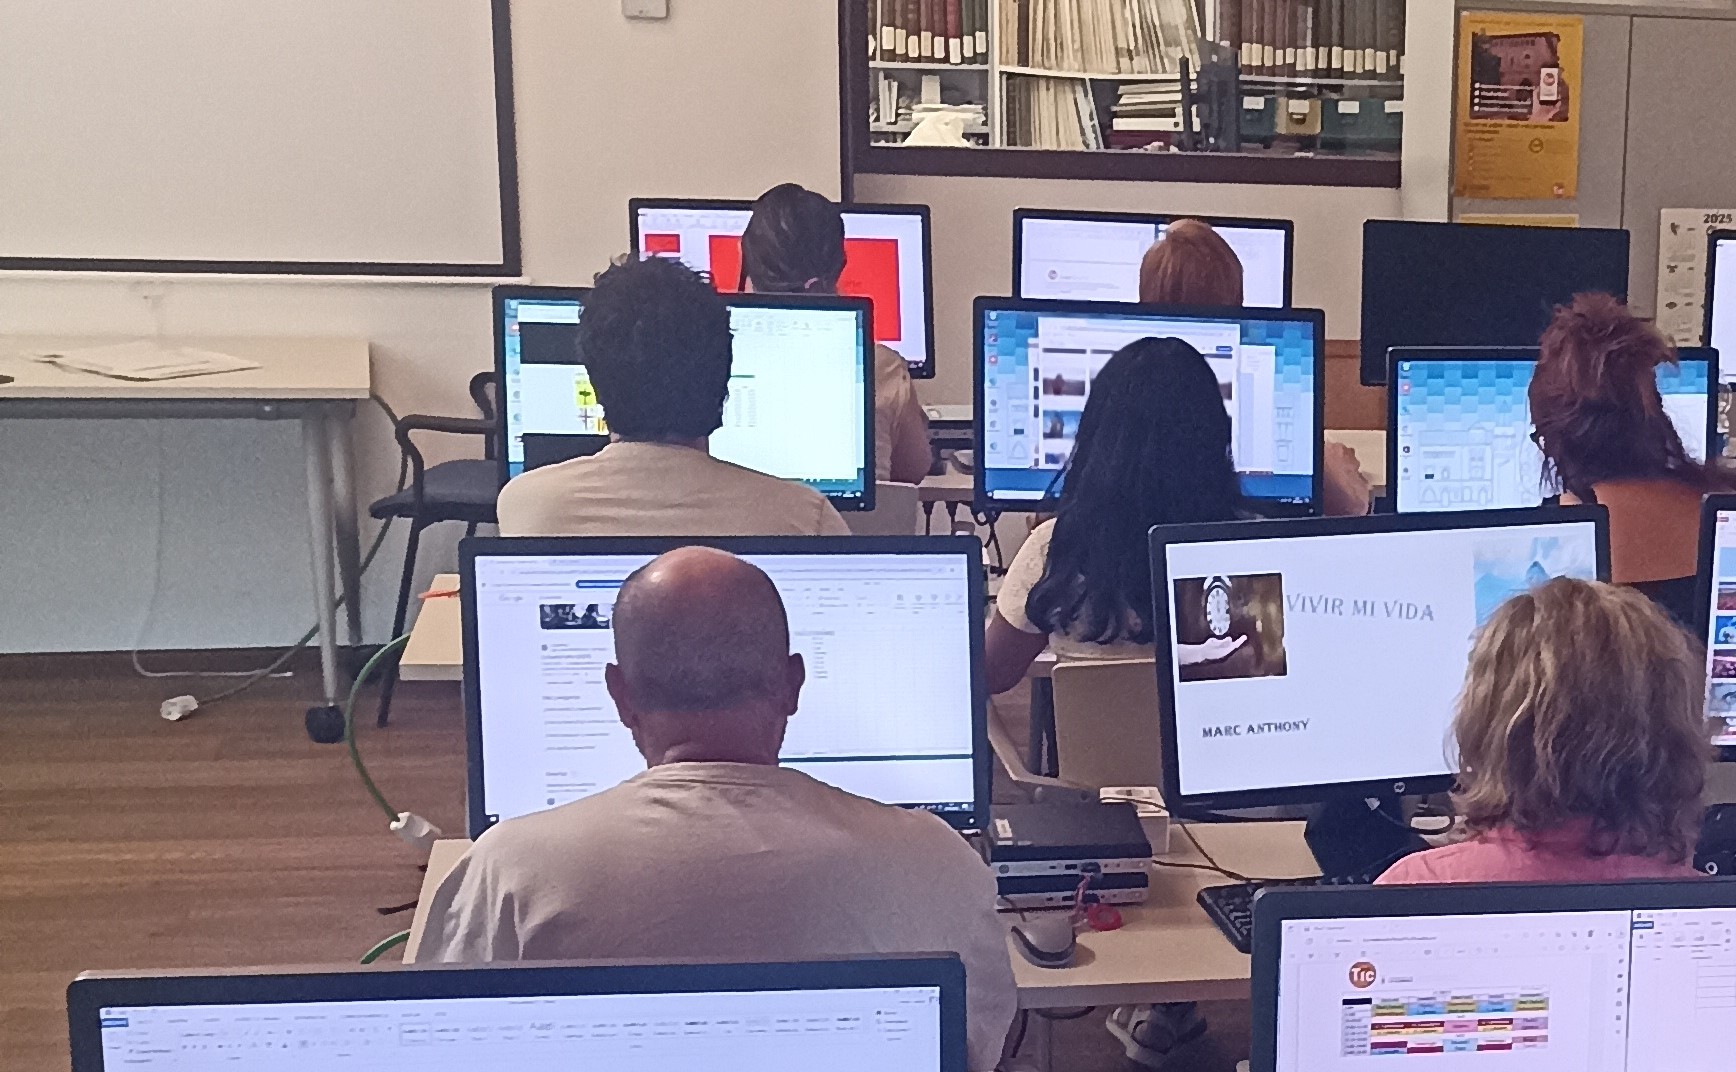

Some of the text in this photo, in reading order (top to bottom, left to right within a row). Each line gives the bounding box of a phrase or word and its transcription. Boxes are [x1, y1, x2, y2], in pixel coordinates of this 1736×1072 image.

[1703, 213, 1733, 224] 2025
[1286, 592, 1434, 622] VIVIR MI VIDA
[1202, 718, 1310, 738] MARC ANTHONY
